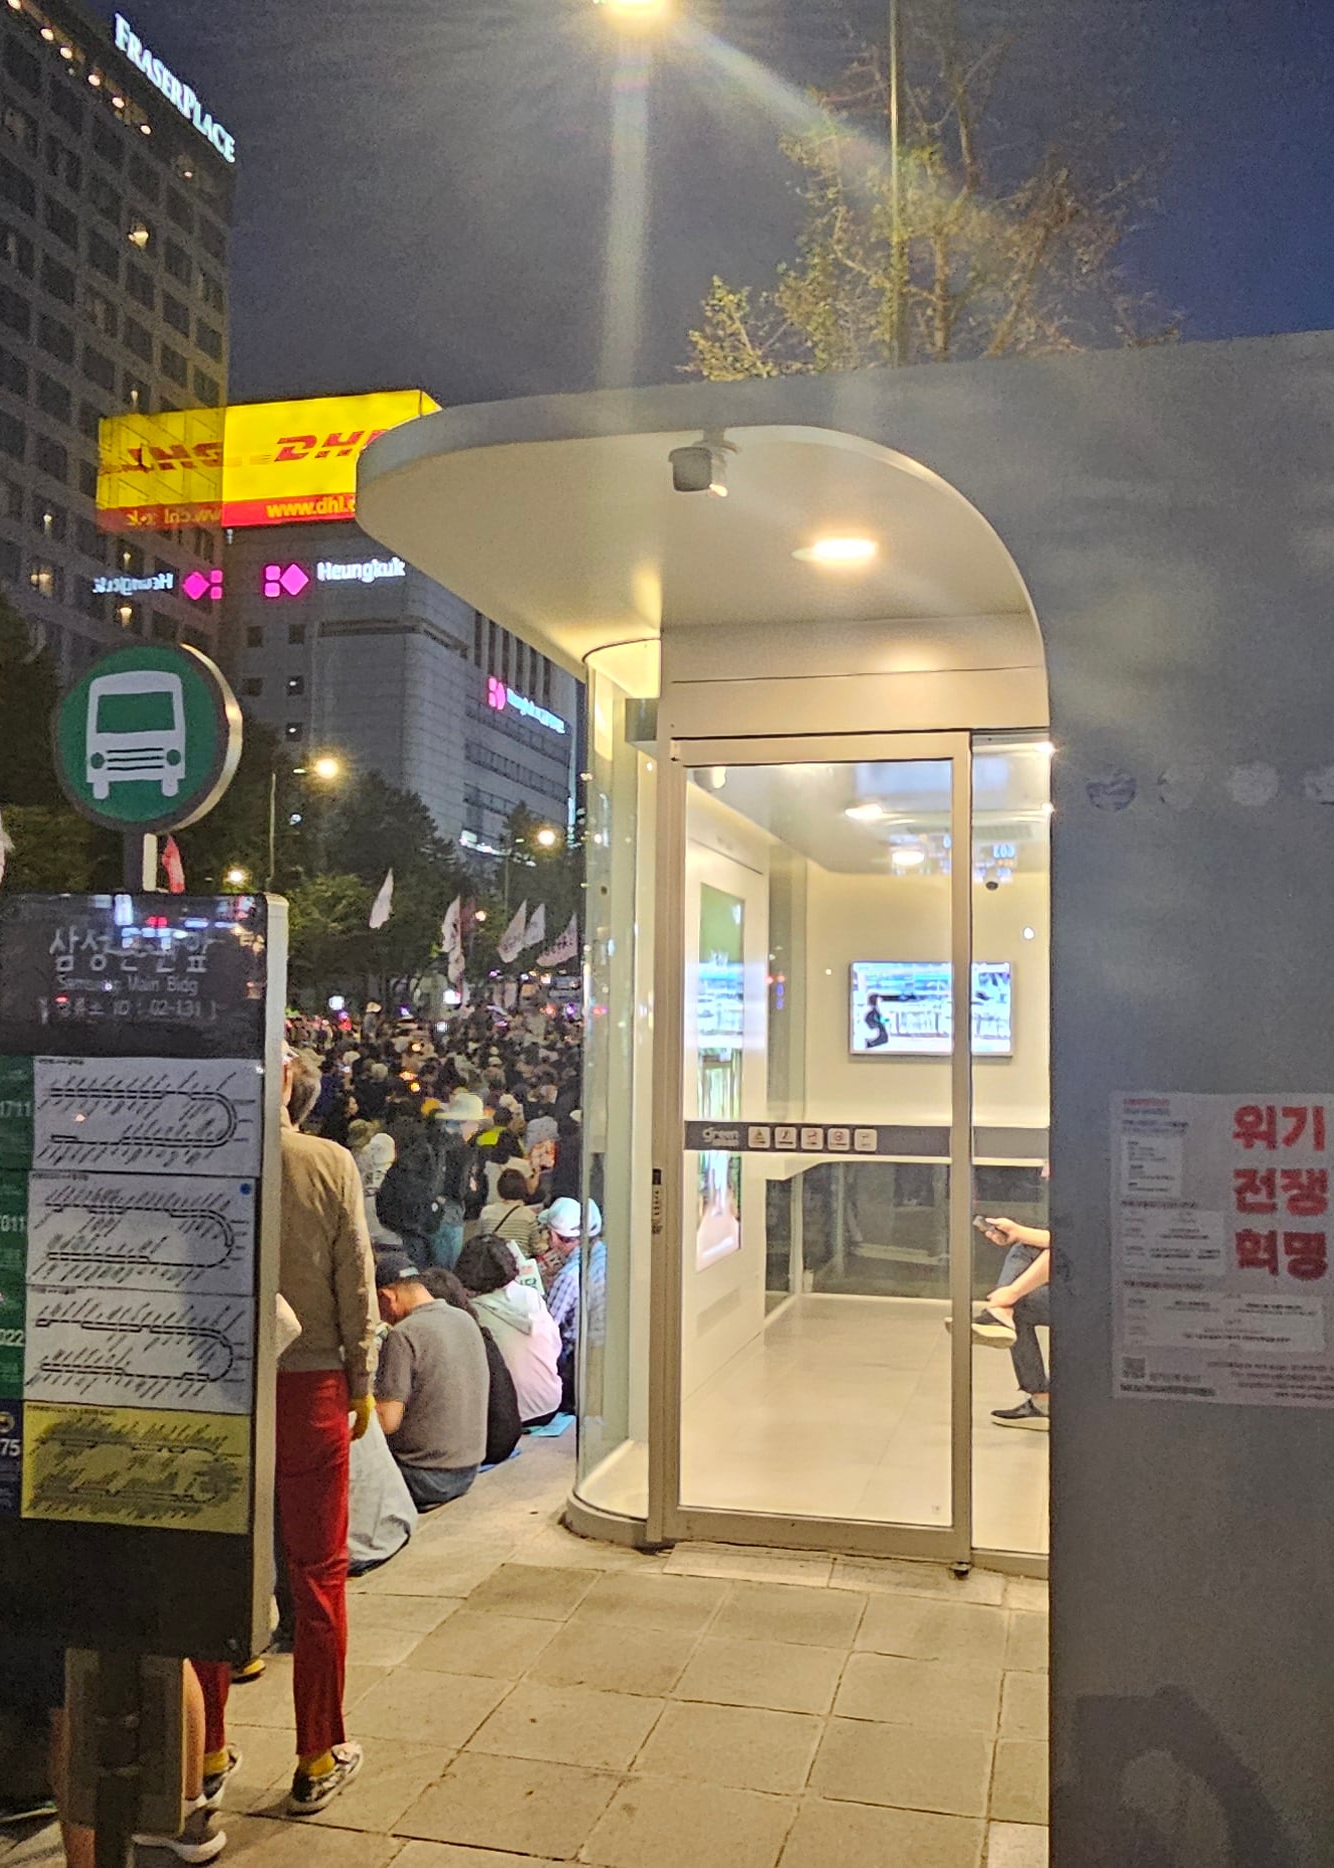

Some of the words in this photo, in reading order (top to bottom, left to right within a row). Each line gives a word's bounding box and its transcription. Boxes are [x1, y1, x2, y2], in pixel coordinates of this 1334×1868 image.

[273, 428, 388, 462] DH
[316, 557, 406, 584] Heungkuk
[1231, 1104, 1326, 1151] 위기
[1233, 1168, 1329, 1216] 전쟁
[1235, 1228, 1329, 1281] 혁명
